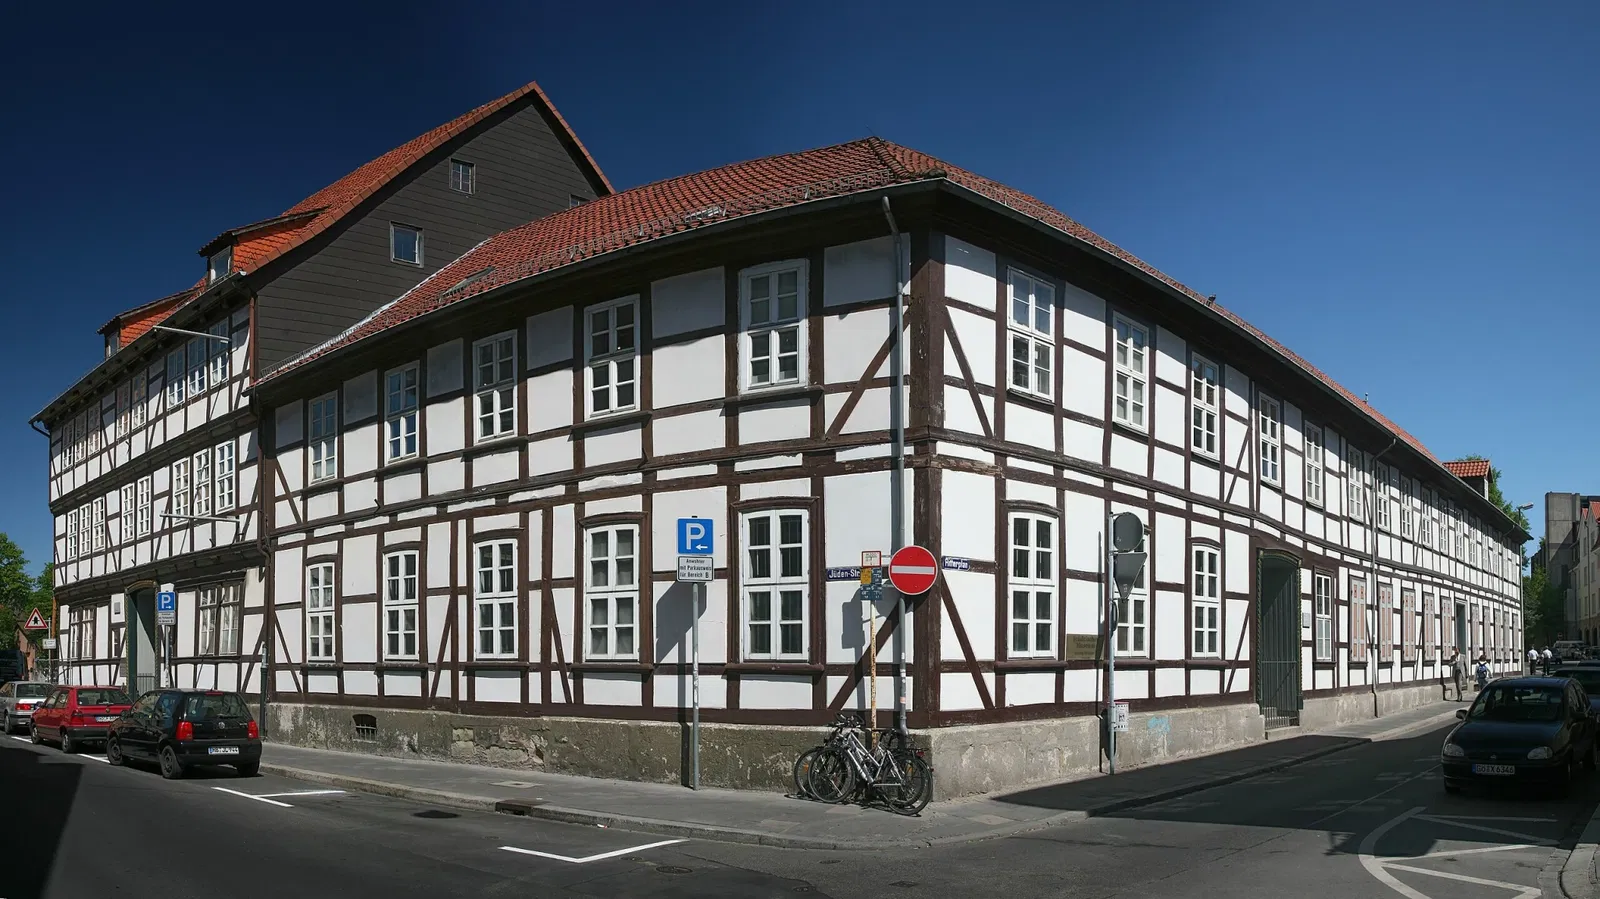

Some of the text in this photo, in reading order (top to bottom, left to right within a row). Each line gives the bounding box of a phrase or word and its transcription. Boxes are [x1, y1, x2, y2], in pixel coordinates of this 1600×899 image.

[686, 522, 705, 550] P
[828, 568, 861, 579] Jüden-Str
[161, 594, 171, 609] P
